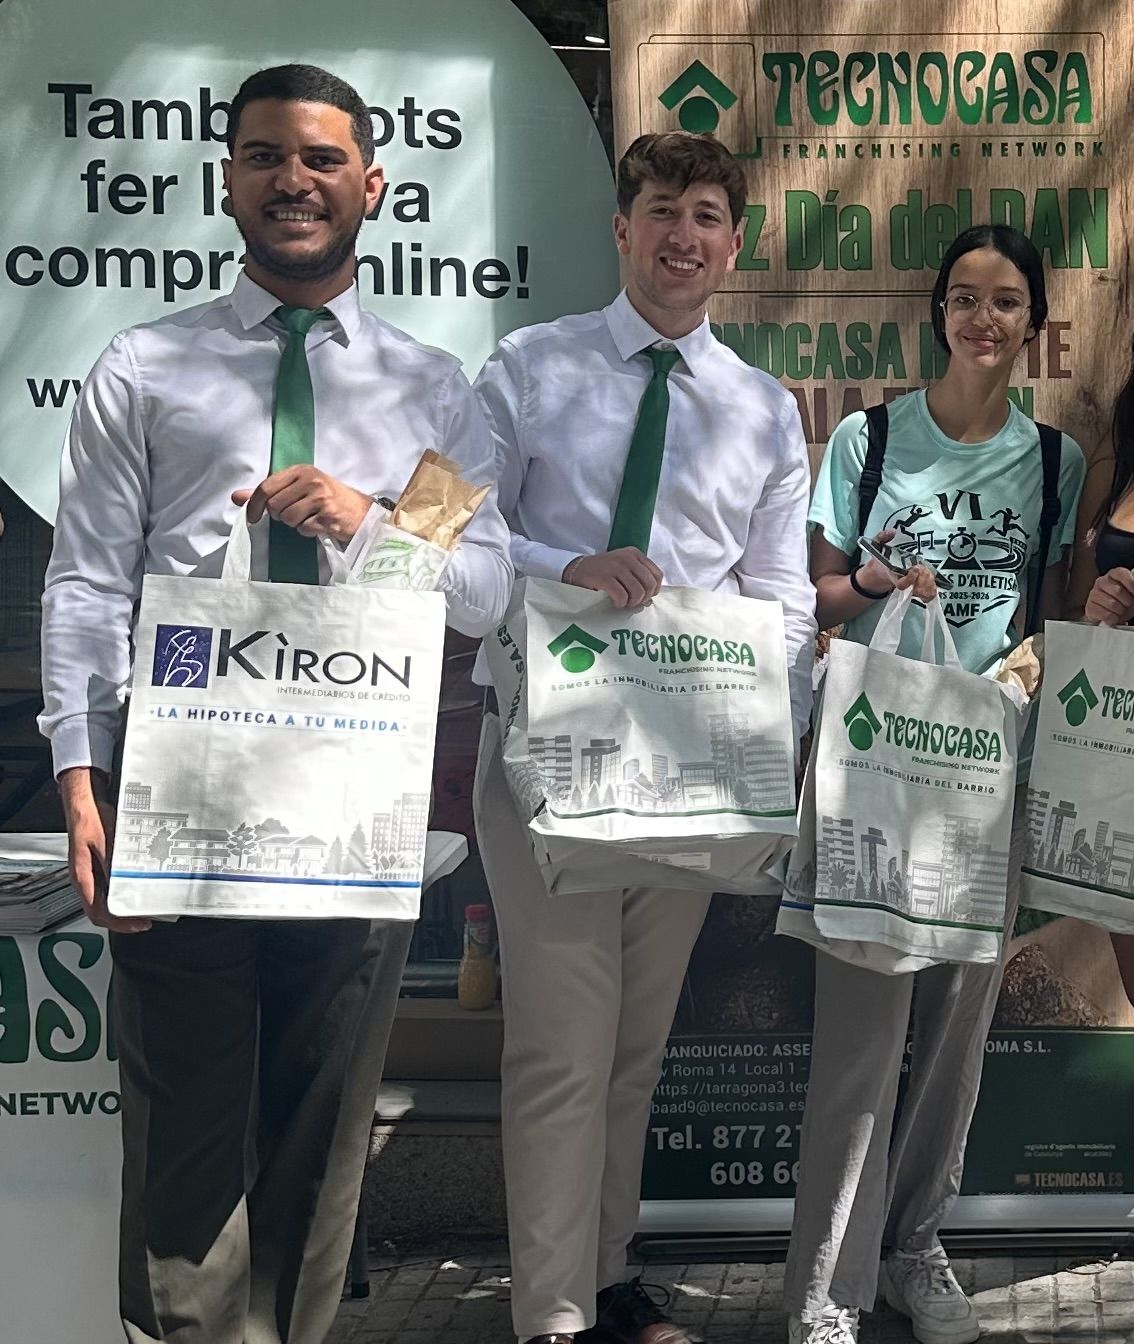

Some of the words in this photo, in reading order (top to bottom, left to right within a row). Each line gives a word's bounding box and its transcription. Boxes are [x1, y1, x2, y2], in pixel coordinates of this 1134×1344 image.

[762, 50, 1093, 126] TECNOCASA
[48, 83, 229, 141] Tamb
[368, 96, 462, 149] ots
[783, 143, 961, 159] FRANCHISING
[982, 141, 1104, 157] NETWORK
[81, 159, 178, 214] fer
[785, 189, 872, 271] Día
[890, 189, 973, 270] del
[6, 245, 246, 302] compr
[357, 242, 529, 299] nline!
[933, 489, 986, 520] VI
[611, 629, 755, 666] TECNOCASA
[552, 679, 590, 691] SOMOS
[614, 676, 686, 693] INMOBILIARIA
[716, 683, 757, 691] BARRIO
[157, 707, 178, 718] LA
[188, 709, 277, 725] HIPOTECA
[285, 715, 295, 725] A
[305, 716, 325, 727] TU
[334, 718, 399, 731] MEDIDA
[884, 711, 1001, 762] TECNOCASA
[957, 782, 994, 794] BARRIO
[665, 1044, 767, 1058] ANQUICIADO:
[773, 1043, 811, 1056] ASSE
[985, 1041, 1019, 1053] OMA
[1023, 1040, 1051, 1053] S.L.
[673, 1063, 714, 1077] Roma
[720, 1063, 736, 1075] 14
[745, 1062, 783, 1075] Local
[789, 1061, 795, 1074] 1
[0, 1091, 122, 1116] NETWO
[651, 1125, 701, 1150] Tel.
[713, 1125, 765, 1149] 877
[711, 1161, 764, 1185] 608
[1034, 1172, 1123, 1187] TECNOCASA.ES
